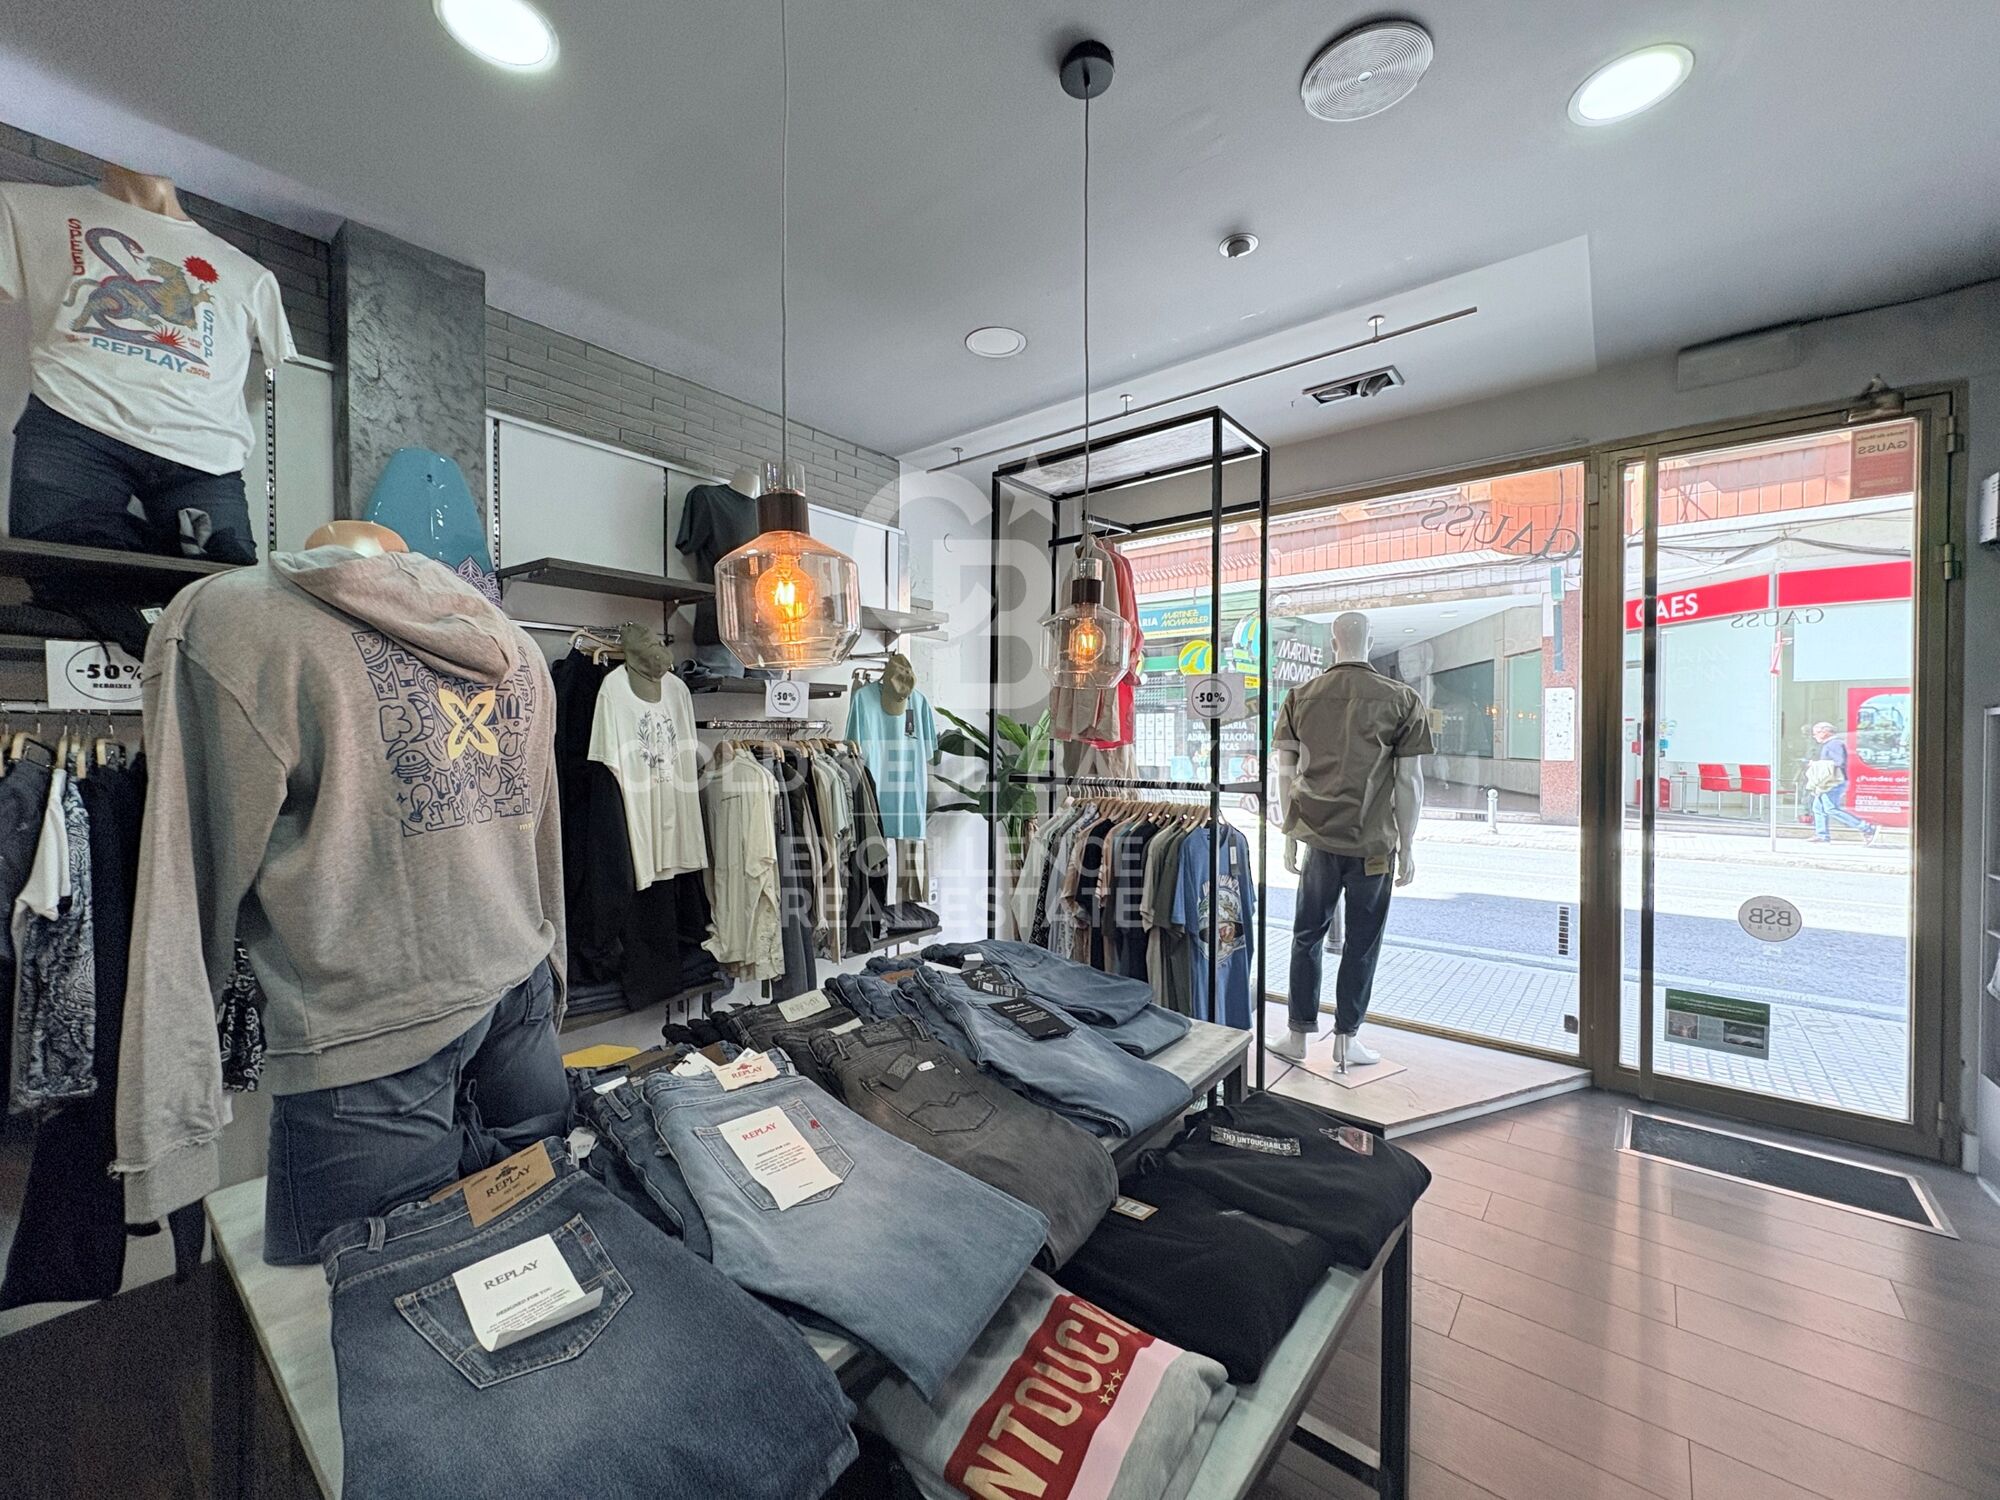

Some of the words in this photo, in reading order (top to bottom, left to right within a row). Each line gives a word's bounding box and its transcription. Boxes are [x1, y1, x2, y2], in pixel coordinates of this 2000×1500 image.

[68, 218, 85, 275] SPEED
[203, 309, 215, 358] SHOP
[91, 336, 188, 373] REPLAY
[76, 664, 142, 680] -50%
[774, 692, 797, 702] -50%
[1195, 692, 1226, 703] -50%
[731, 1065, 763, 1079] REPLAY
[741, 1122, 777, 1141] REPLAY
[486, 1164, 531, 1198] REPLAY
[484, 1259, 538, 1290] REPLAY
